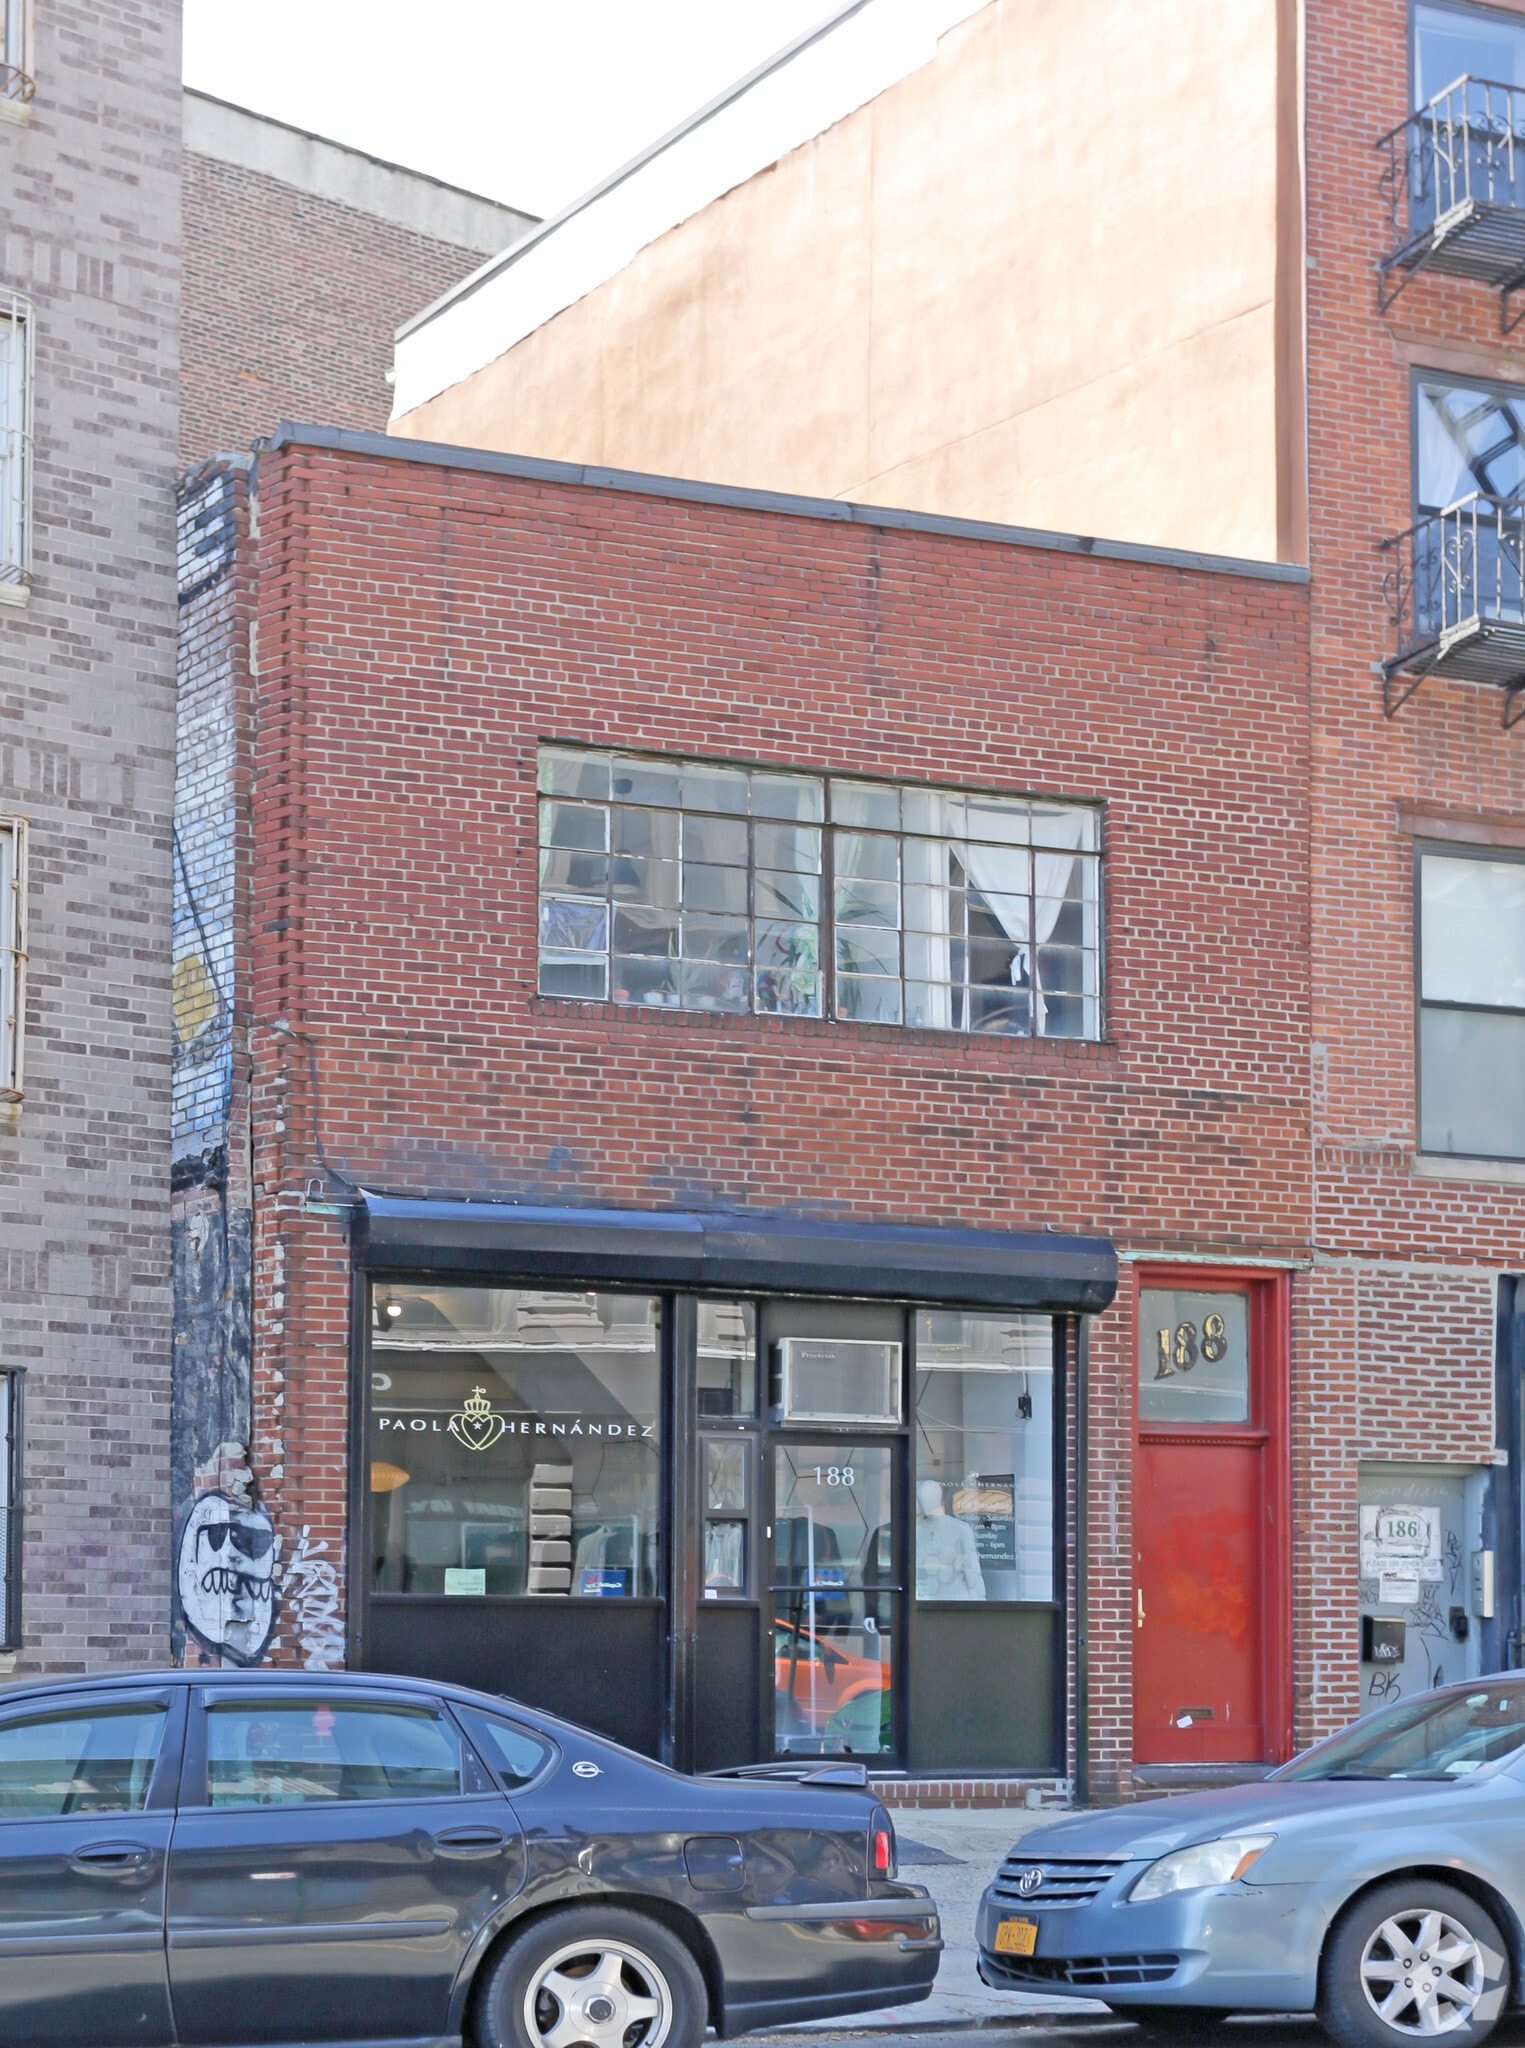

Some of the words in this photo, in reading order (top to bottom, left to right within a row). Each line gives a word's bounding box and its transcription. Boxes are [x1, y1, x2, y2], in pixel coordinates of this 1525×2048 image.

[1154, 1313, 1228, 1380] 188
[379, 1418, 460, 1432] PAOLA
[502, 1419, 654, 1437] HERNÁNDEZ
[813, 1466, 855, 1487] 188
[975, 1502, 1014, 1511] Broadway
[987, 1514, 1015, 1523] Saturday
[1387, 1521, 1418, 1538] 186
[974, 1532, 998, 1541] Sunday
[990, 1542, 1006, 1550] 6pm
